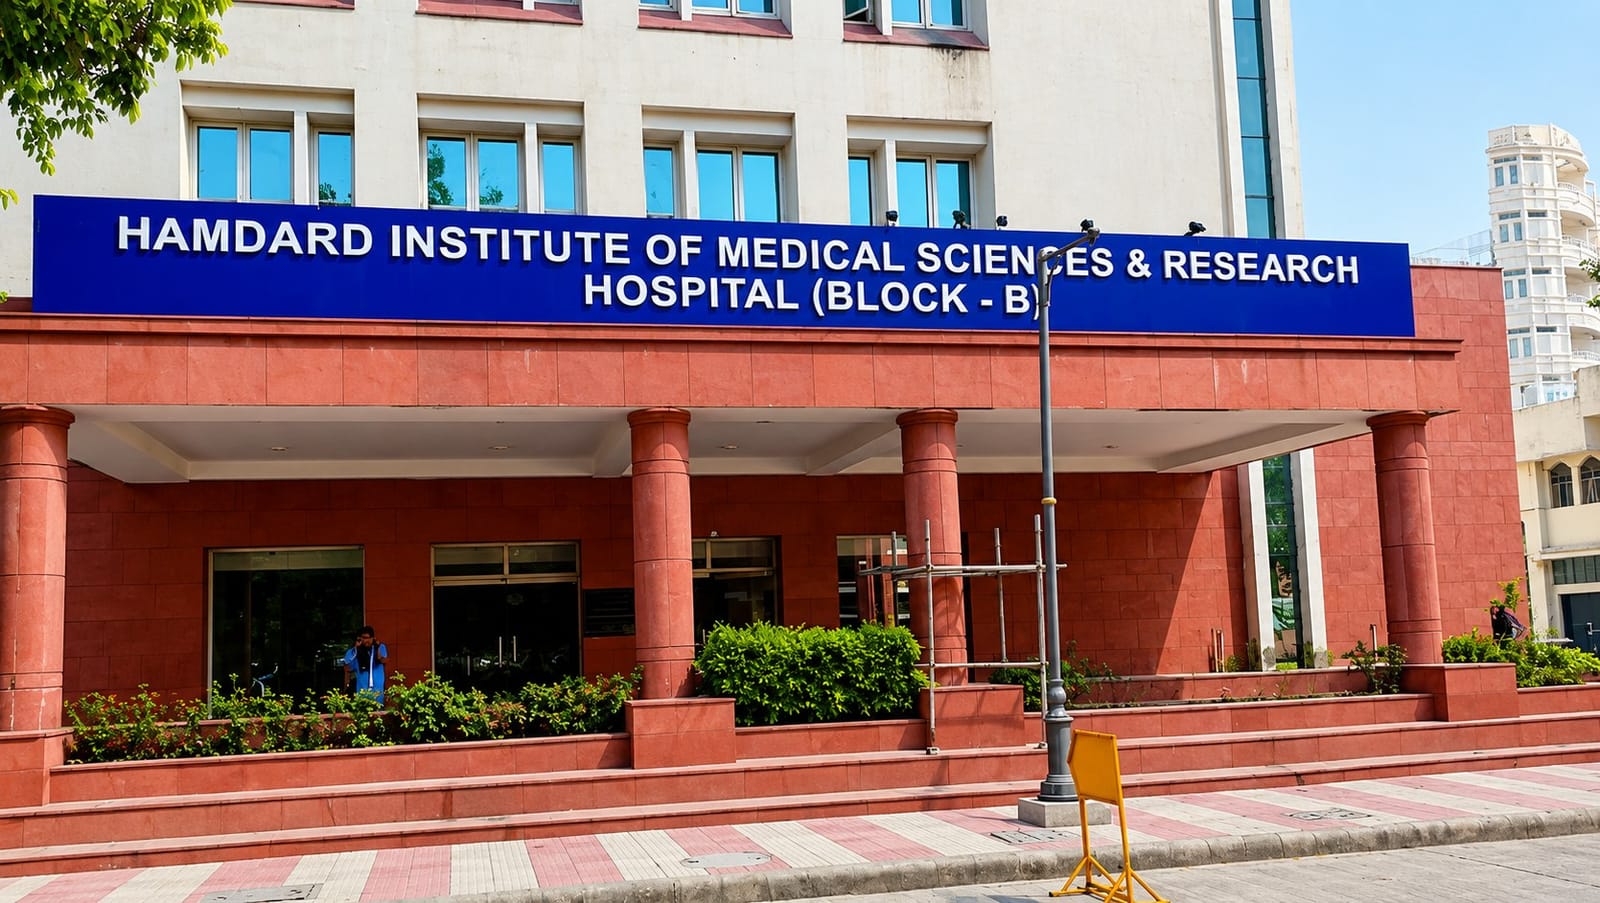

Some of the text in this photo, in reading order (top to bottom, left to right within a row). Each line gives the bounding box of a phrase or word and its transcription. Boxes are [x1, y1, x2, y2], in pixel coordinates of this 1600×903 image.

[118, 215, 373, 257] HAMDARD
[391, 224, 631, 266] INSTITUTE
[645, 234, 703, 268] OF
[718, 236, 906, 273] MEDICAL
[1127, 248, 1152, 279] &
[1163, 250, 1360, 285] RESEARCH
[584, 274, 1041, 321] HOSPITAL (BLOCK - B)
